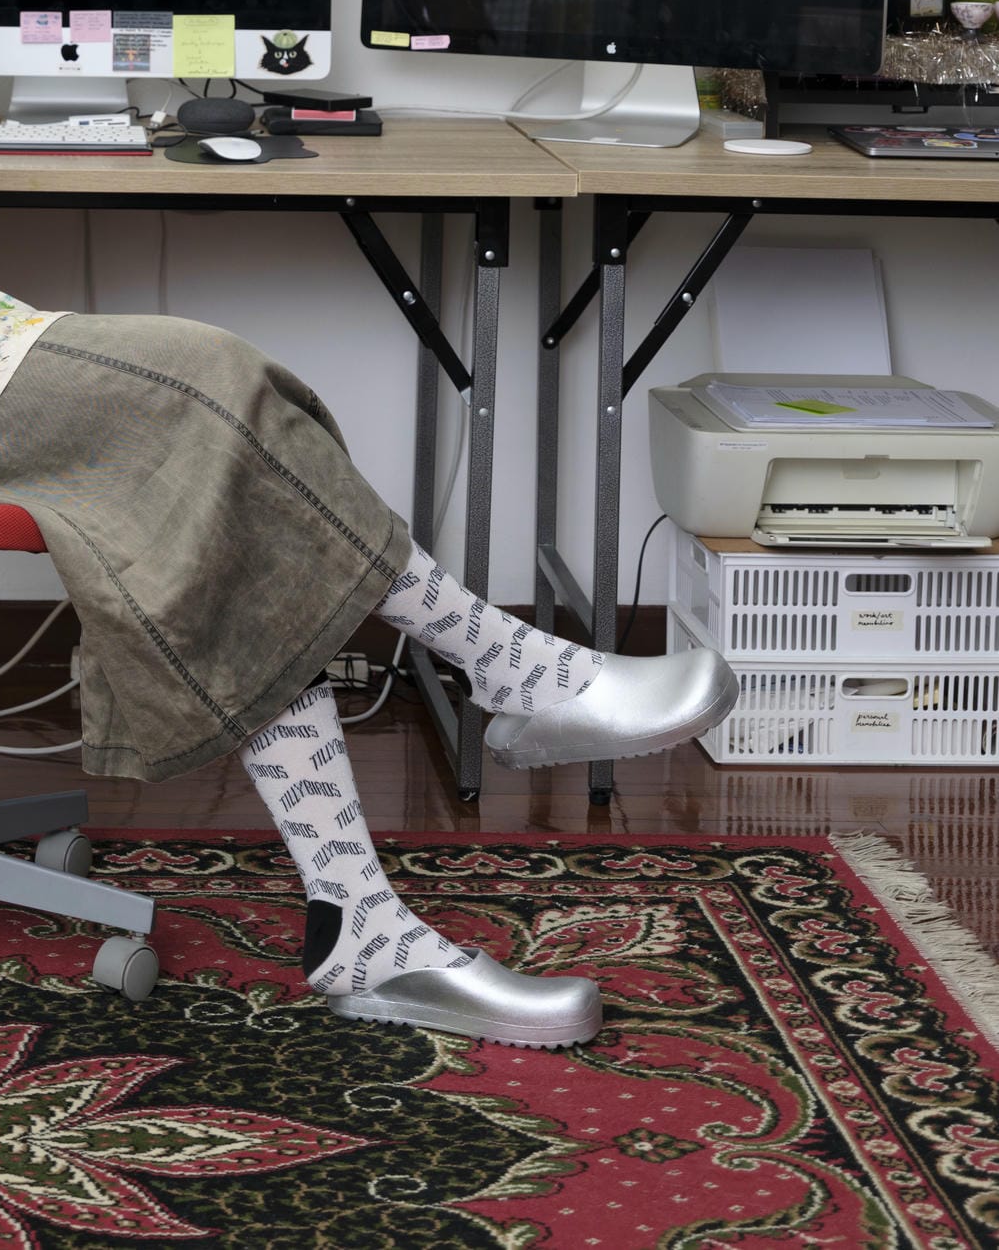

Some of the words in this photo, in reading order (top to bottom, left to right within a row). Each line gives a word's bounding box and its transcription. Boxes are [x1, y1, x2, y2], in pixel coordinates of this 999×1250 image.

[474, 641, 504, 692] TILLYBIRDS
[510, 622, 534, 670] TILLYBIRD
[519, 663, 547, 712] TILLYBIRDS
[248, 723, 320, 756] TILLYBIRDS
[279, 779, 342, 812] TILLYBIRDS
[311, 840, 367, 872] TILLYBIRDS
[308, 878, 349, 900] LLYBIRDS
[351, 889, 394, 940] TILLYBIRDS
[352, 933, 390, 995] TILLYBIRDS
[394, 924, 431, 970] TILLYBIRDS
